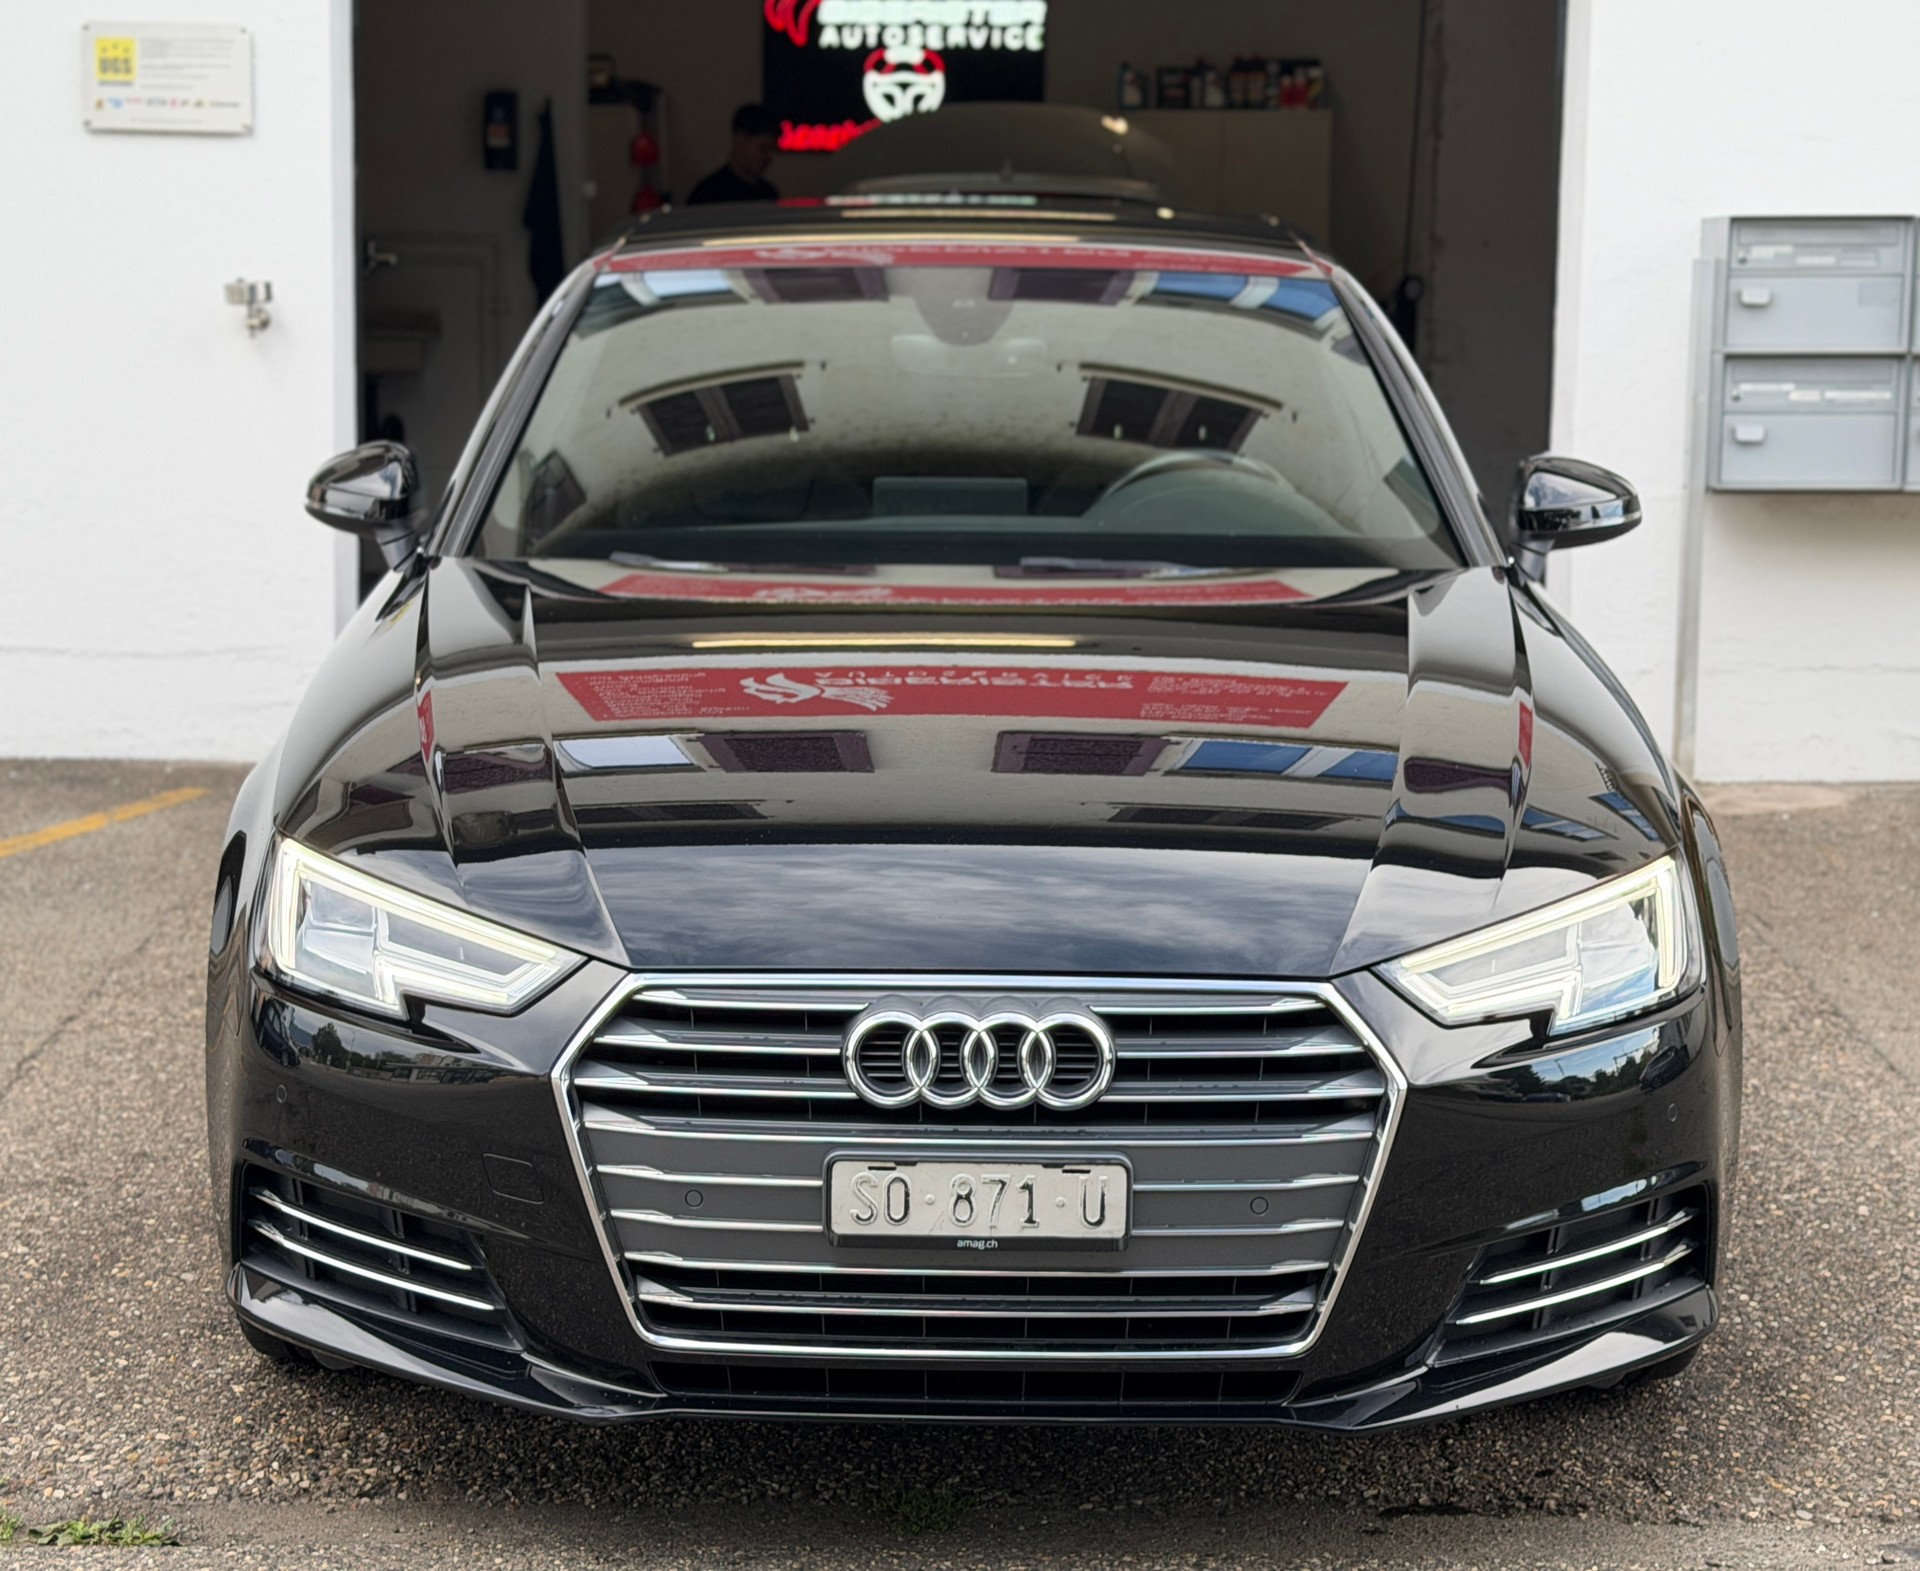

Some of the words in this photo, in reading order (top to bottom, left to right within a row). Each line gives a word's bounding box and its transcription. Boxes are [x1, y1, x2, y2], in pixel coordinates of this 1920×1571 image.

[819, 24, 1044, 50] AUTOSERVICE
[850, 1171, 912, 1226] SO
[949, 1173, 1040, 1229] 871
[1078, 1174, 1109, 1229] U
[956, 1239, 998, 1250] amag.ch
